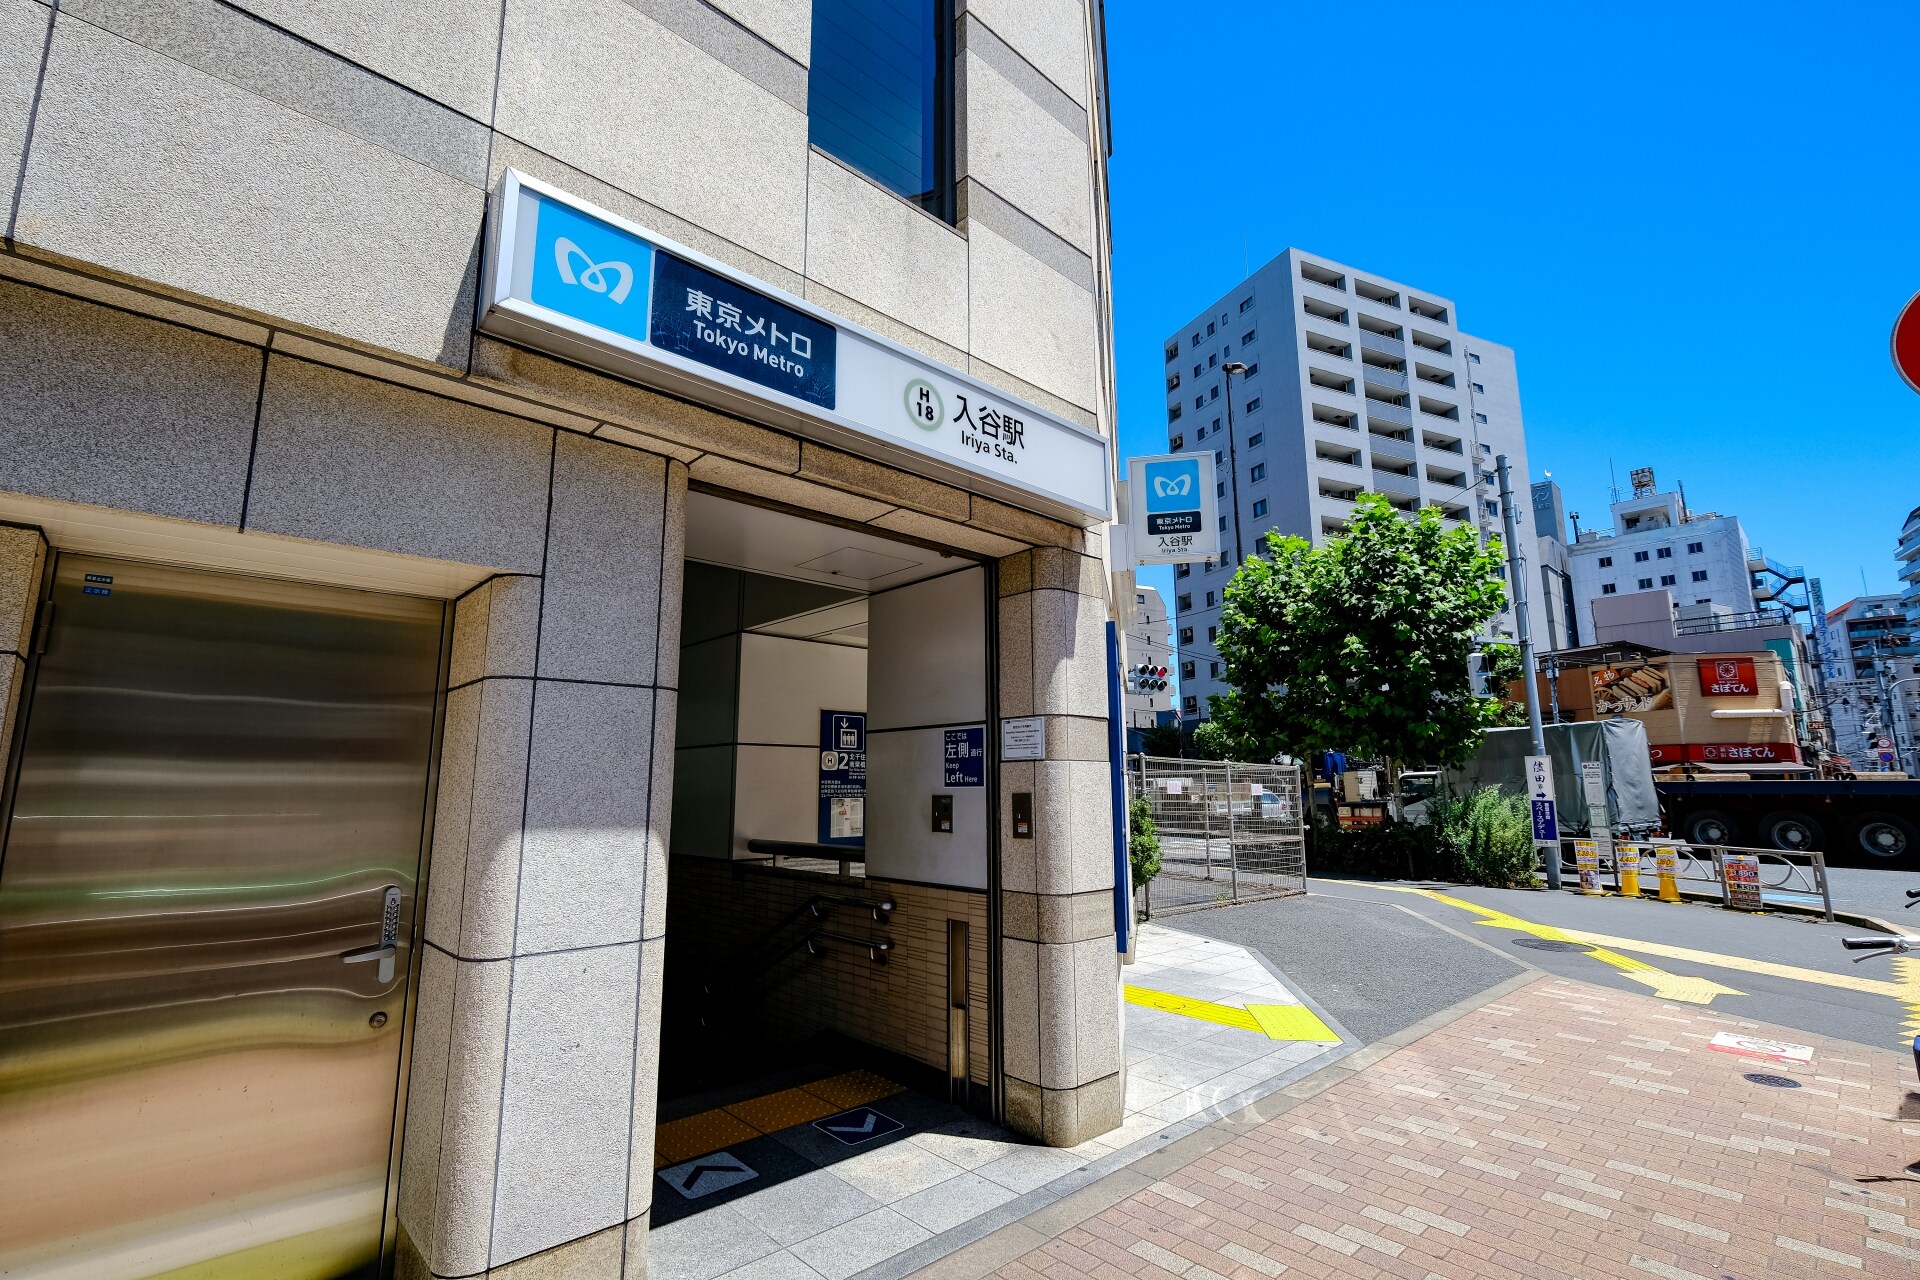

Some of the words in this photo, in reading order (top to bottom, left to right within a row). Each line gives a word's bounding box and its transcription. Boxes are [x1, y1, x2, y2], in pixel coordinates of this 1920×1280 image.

[685, 287, 812, 360] 東京メトロ
[693, 319, 749, 356] Tokyo
[753, 343, 804, 378] Metro
[919, 386, 930, 403] H
[916, 401, 934, 421] 18
[953, 394, 1025, 450] 入谷駅
[961, 430, 990, 454] Iriya
[994, 443, 1018, 464] Sta.
[1156, 516, 1193, 525] 東京メトロ
[1158, 535, 1193, 547] 入谷駅
[1161, 547, 1176, 555] Iriya
[1711, 683, 1749, 693] さぼてん
[1596, 695, 1653, 714] かつサンド
[945, 732, 968, 741] ここでは
[1728, 746, 1775, 758] さぼてん
[827, 757, 833, 765] H
[838, 752, 849, 770] 2
[945, 762, 960, 770] Keep
[945, 771, 964, 783] Left
[964, 775, 978, 783] Here
